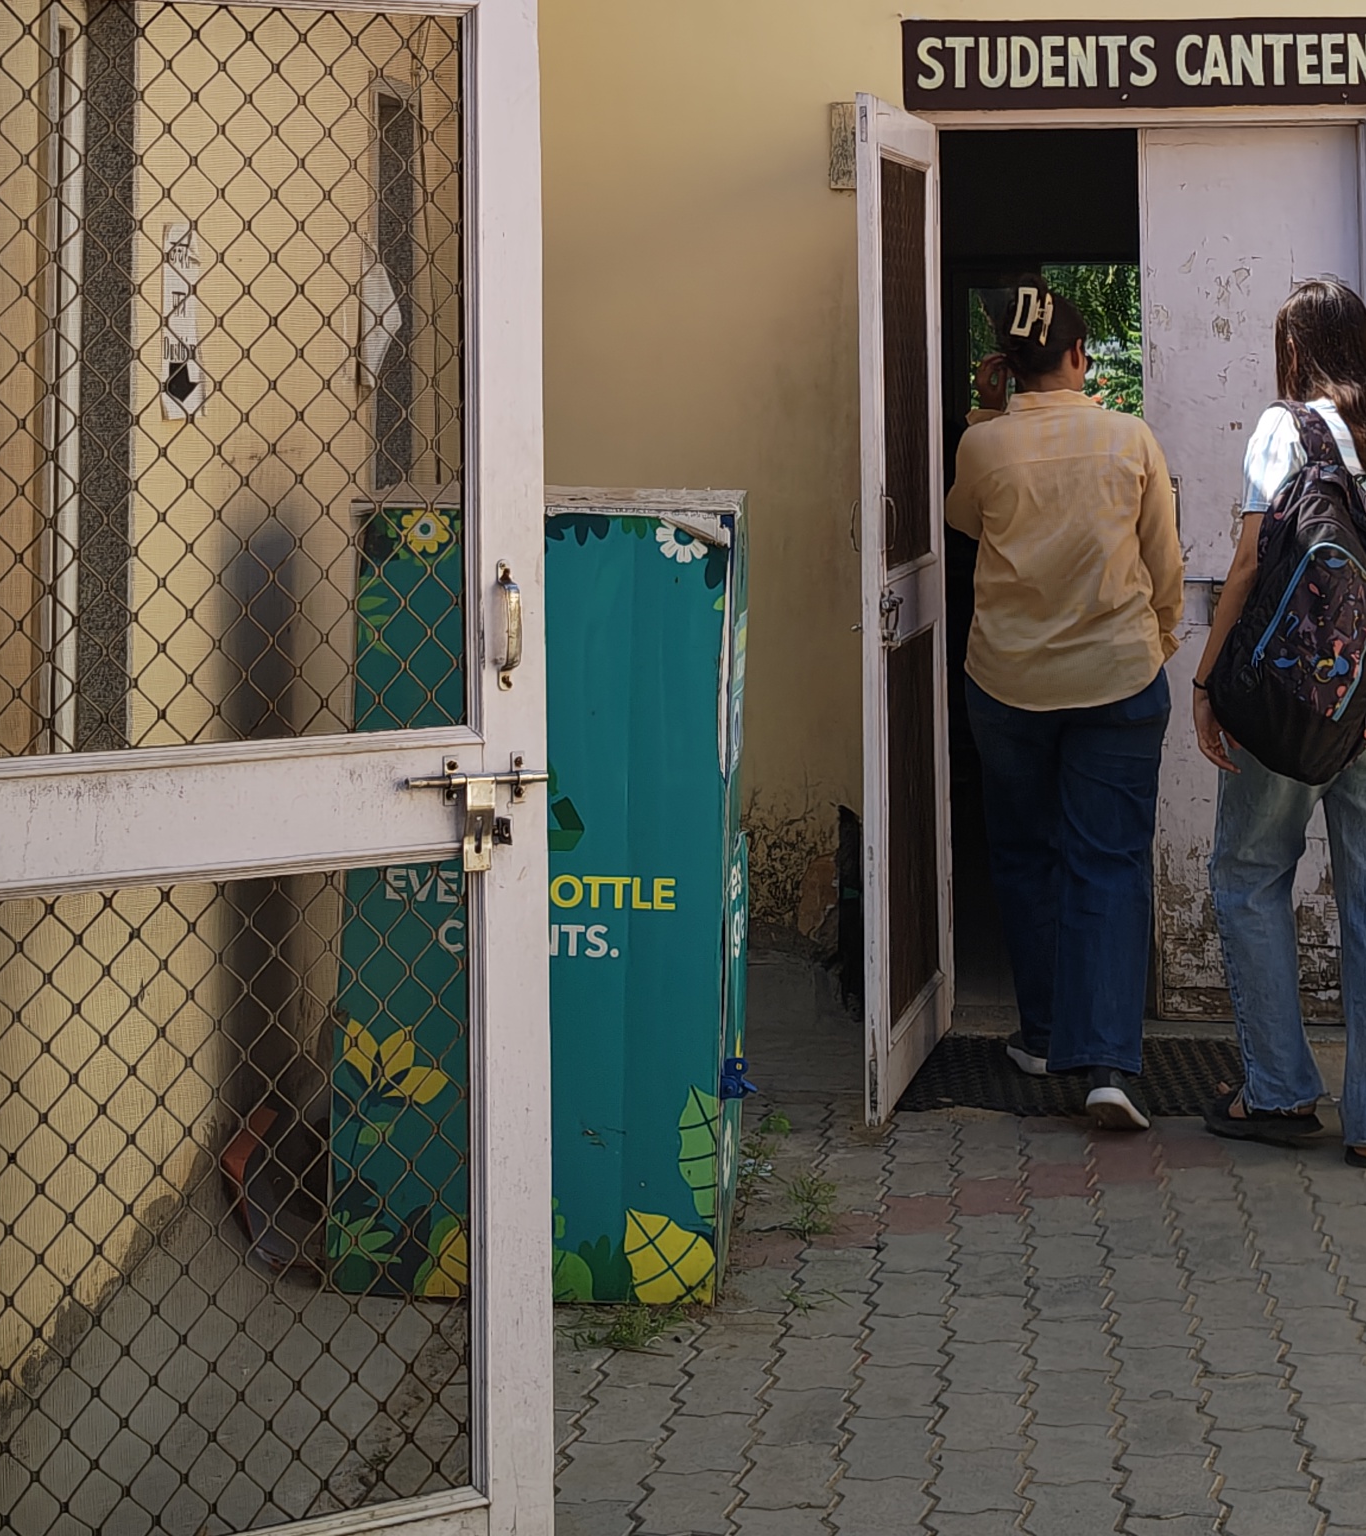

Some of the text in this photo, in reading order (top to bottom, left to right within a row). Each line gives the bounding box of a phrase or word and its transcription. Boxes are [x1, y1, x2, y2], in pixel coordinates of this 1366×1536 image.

[916, 35, 1157, 89] STUDENTS
[385, 868, 677, 911] EVE OTTLE
